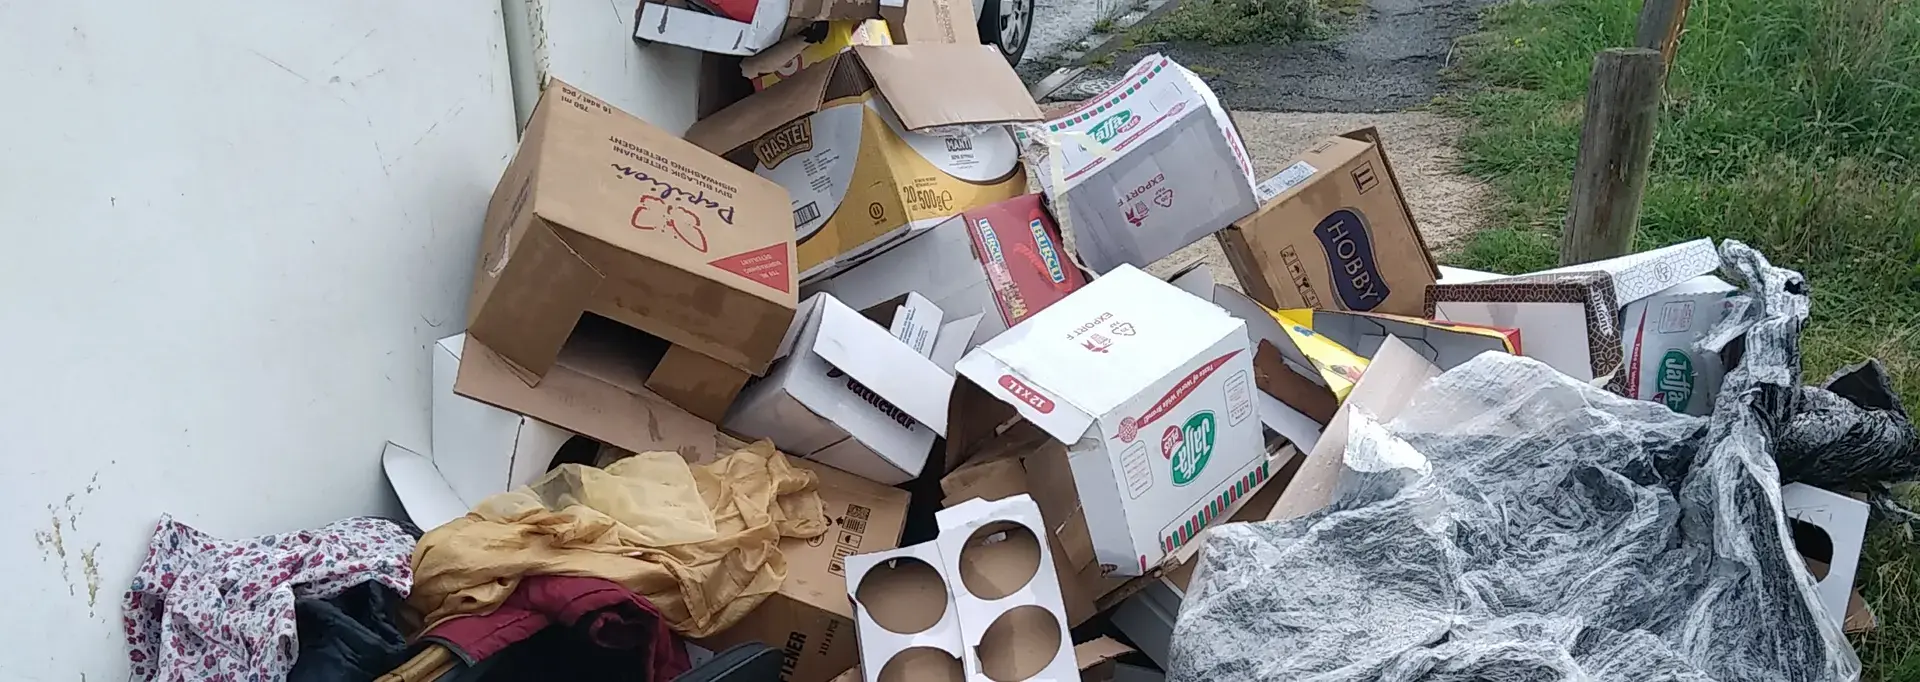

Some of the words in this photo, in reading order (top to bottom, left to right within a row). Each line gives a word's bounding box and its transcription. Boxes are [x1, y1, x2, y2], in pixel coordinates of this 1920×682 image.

[573, 101, 589, 112] 750
[607, 135, 669, 164] DETERGENT
[760, 124, 809, 162] HASTEL
[612, 145, 669, 172] DETERJANI
[669, 160, 738, 193] DISHWASHING
[1123, 173, 1165, 202] EXPORT
[610, 165, 734, 225] Papilion
[902, 184, 917, 203] 20
[1032, 223, 1061, 278] BURCU
[1327, 220, 1378, 300] HOBBY
[1072, 311, 1113, 337] EXPORT
[1191, 373, 1200, 384] of
[1197, 363, 1214, 377] Taste
[1660, 358, 1691, 409] Jaffa
[1161, 393, 1177, 408] Wide
[1174, 379, 1194, 397] World
[1163, 427, 1179, 453] PLUS
[1174, 418, 1210, 478] Jaffa
